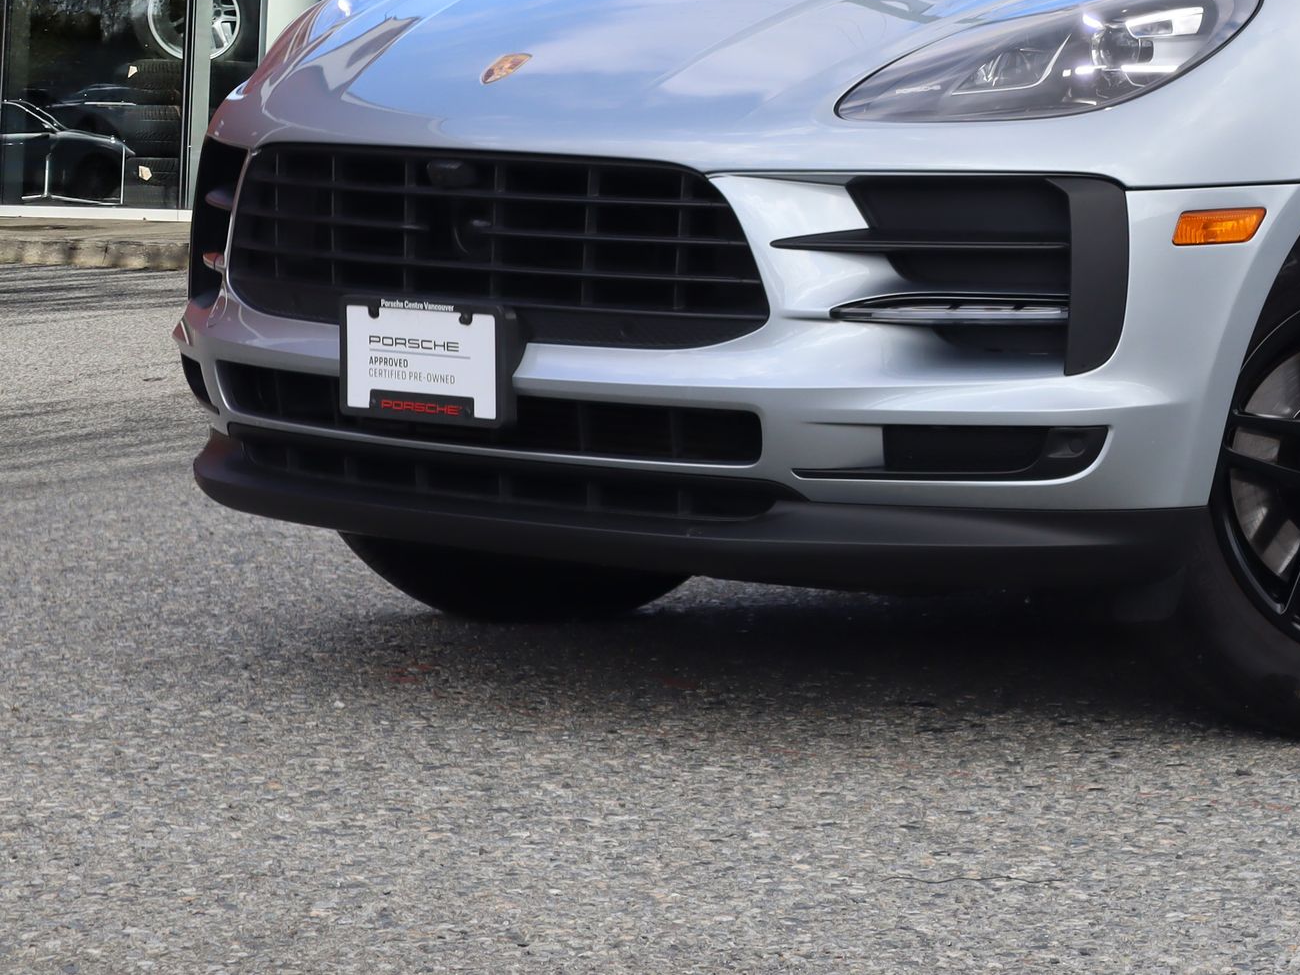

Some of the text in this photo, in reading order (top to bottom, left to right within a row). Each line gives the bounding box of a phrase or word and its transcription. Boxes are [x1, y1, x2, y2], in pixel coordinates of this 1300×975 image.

[380, 299, 454, 311] Porsche Centre Vancouver
[369, 335, 459, 352] PORSCHE
[369, 356, 408, 368] APPROVED
[369, 368, 455, 385] CERTIFIED PRE-OWNED
[381, 400, 459, 416] PORSCHE
